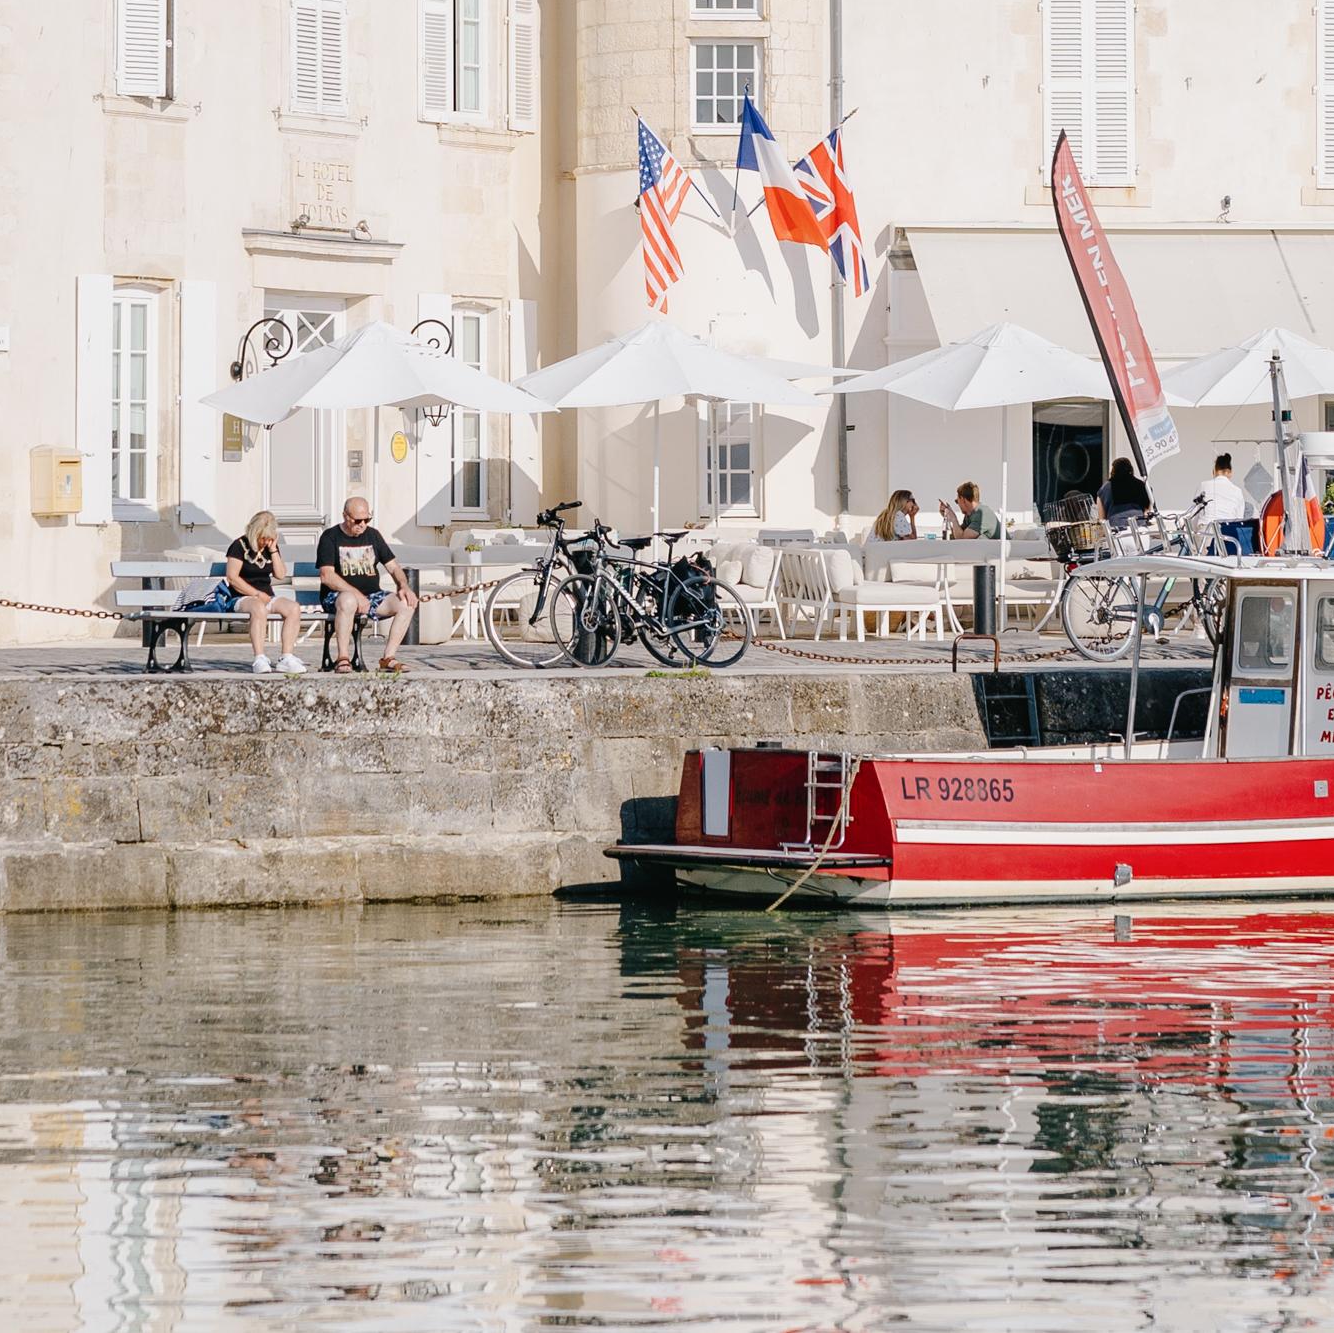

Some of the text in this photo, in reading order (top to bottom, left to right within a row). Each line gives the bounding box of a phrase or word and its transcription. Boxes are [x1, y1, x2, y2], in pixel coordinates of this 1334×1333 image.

[317, 183, 333, 201] DE
[1155, 439, 1167, 450] 90
[901, 776, 1014, 802] LR 928865
